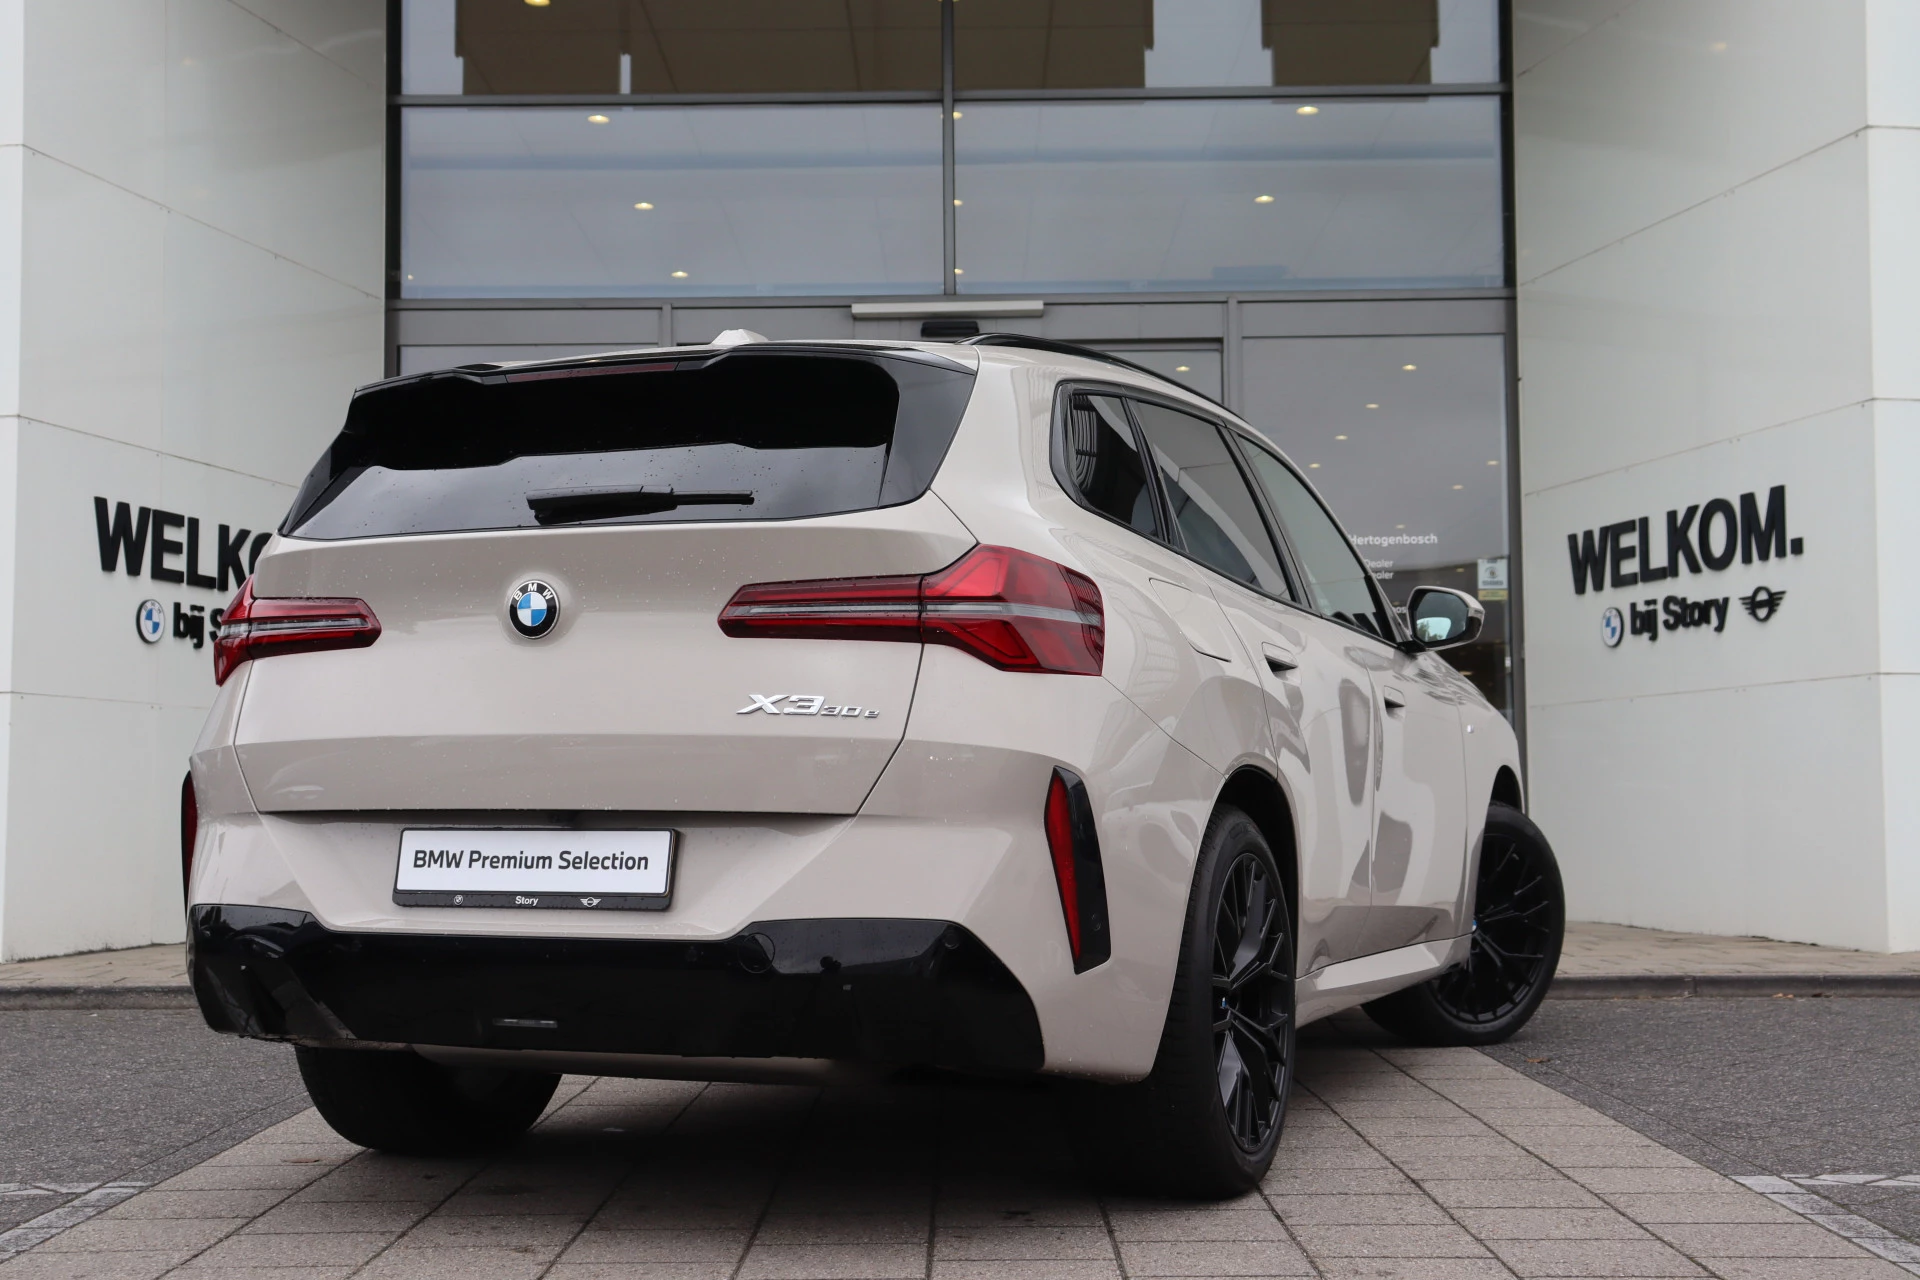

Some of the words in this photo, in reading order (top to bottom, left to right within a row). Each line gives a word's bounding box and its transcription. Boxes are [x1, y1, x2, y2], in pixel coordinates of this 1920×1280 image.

[1348, 533, 1438, 547] Hertogenbosch
[1568, 485, 1803, 595] WELKOM.
[513, 583, 553, 601] BMW
[1630, 599, 1658, 642] bij
[1662, 595, 1730, 633] Story
[413, 850, 464, 869] BMW
[468, 850, 552, 869] Premium
[558, 850, 649, 870] Selection
[515, 896, 539, 906] Story
